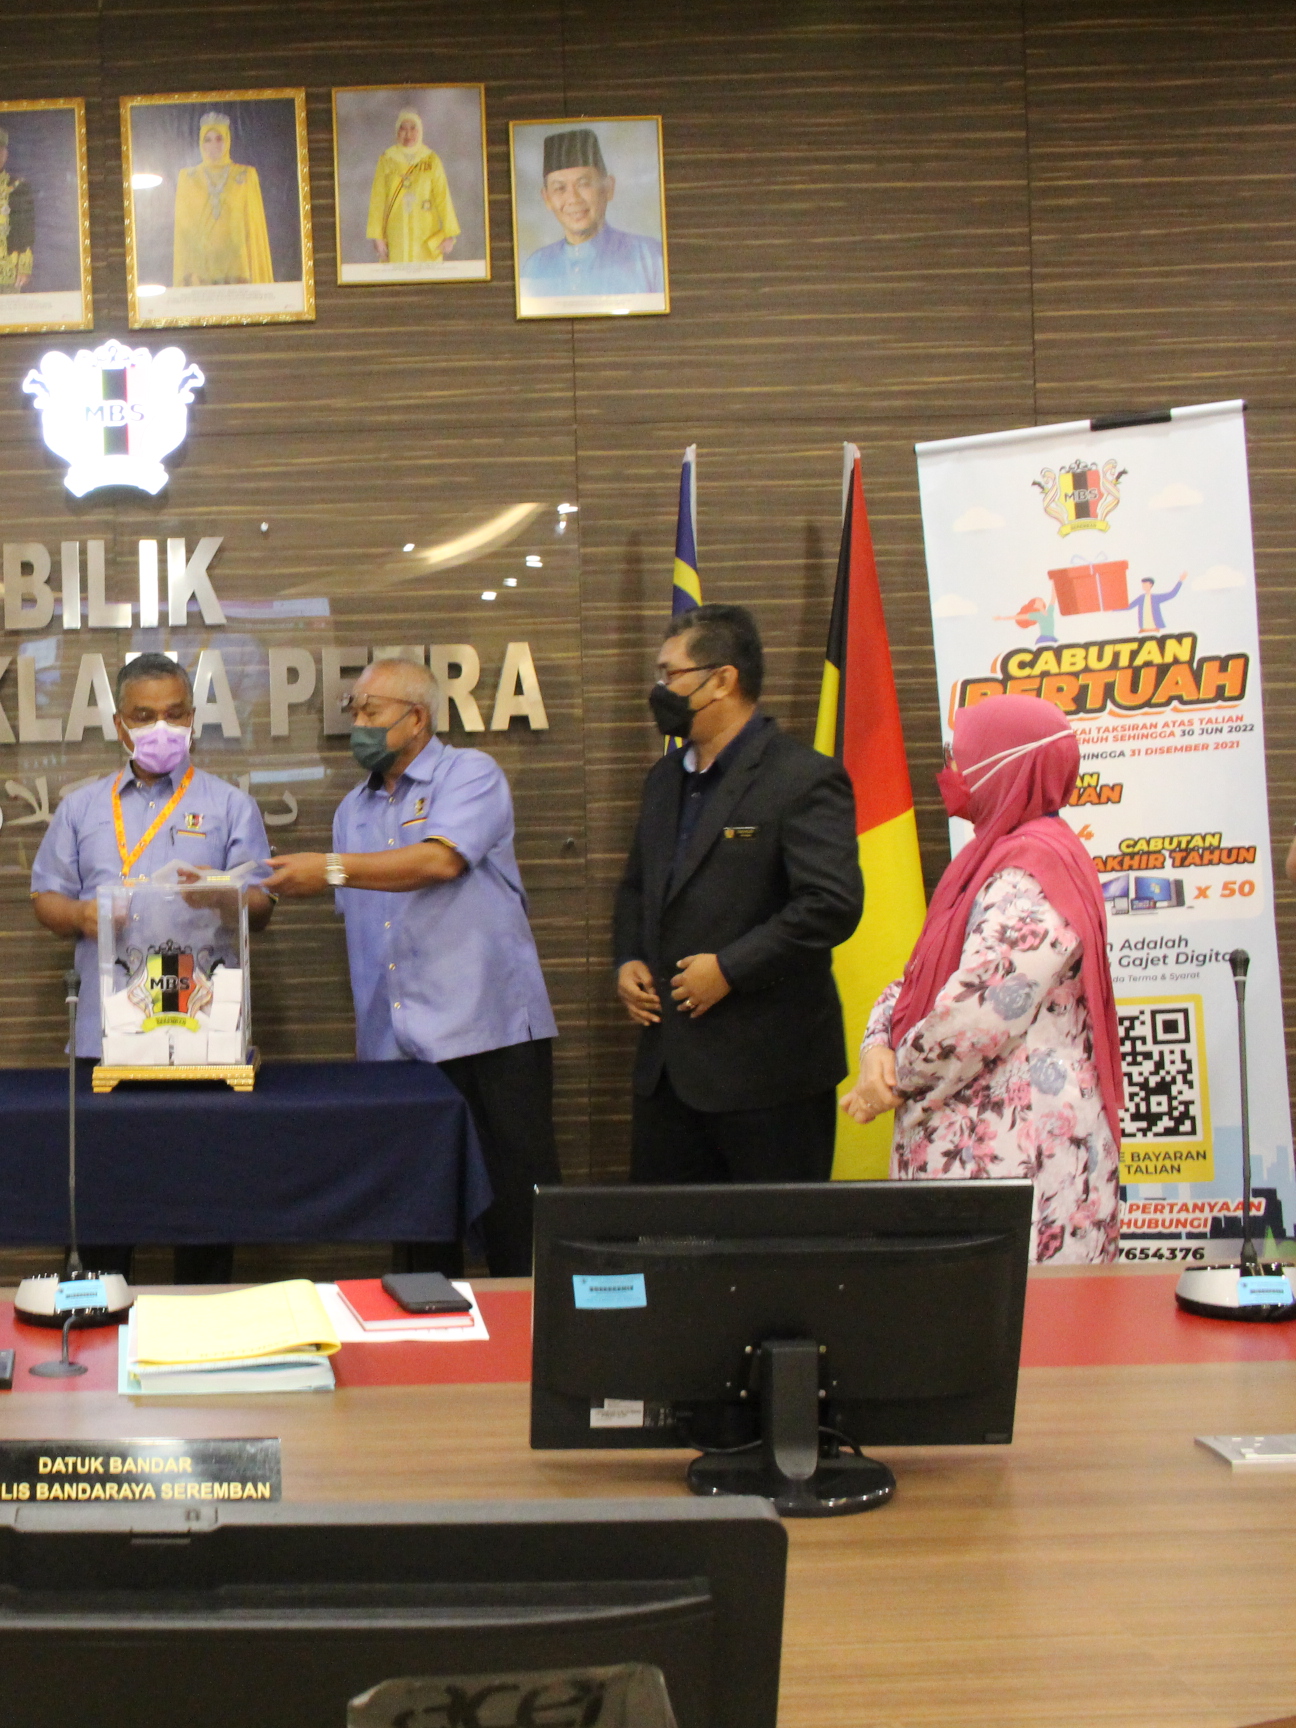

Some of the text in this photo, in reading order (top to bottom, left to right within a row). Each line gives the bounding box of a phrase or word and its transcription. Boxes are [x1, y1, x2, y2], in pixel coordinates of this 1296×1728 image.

[85, 404, 145, 422] MBS
[1064, 488, 1098, 503] MBS
[3, 536, 227, 630] BILIK
[1007, 636, 1193, 678] CABUTAN
[1096, 722, 1158, 734] TAKSIRAN
[1162, 718, 1194, 729] ATAS
[1198, 714, 1244, 726] TALIAN
[1112, 731, 1176, 743] SEHINGGA
[1180, 728, 1195, 738] 30
[1198, 726, 1223, 736] JUN
[1227, 723, 1255, 734] 2022
[1129, 748, 1141, 757] 31
[1145, 743, 1209, 756] DISEMBER
[1213, 740, 1240, 750] 2021
[1077, 824, 1094, 840] 4
[1120, 833, 1222, 853] CABUTAN
[1093, 846, 1257, 873] AKHIR TAHUN
[1220, 880, 1255, 898] 50
[1119, 935, 1189, 952] Adalah
[1118, 953, 1169, 970] Gajet
[150, 976, 190, 990] MBS
[1128, 974, 1158, 983] Terma
[1169, 971, 1200, 982] Syarat
[1131, 1150, 1207, 1162] BAYARAN
[1124, 1164, 1181, 1175] TALIAN
[1128, 1201, 1263, 1214] PERTANYAAN
[1120, 1217, 1209, 1230] HUBUNGI
[38, 1456, 192, 1474] DATUK BANDAR
[36, 1482, 156, 1500] BANDARAYA
[160, 1482, 271, 1500] SEREMBAN
